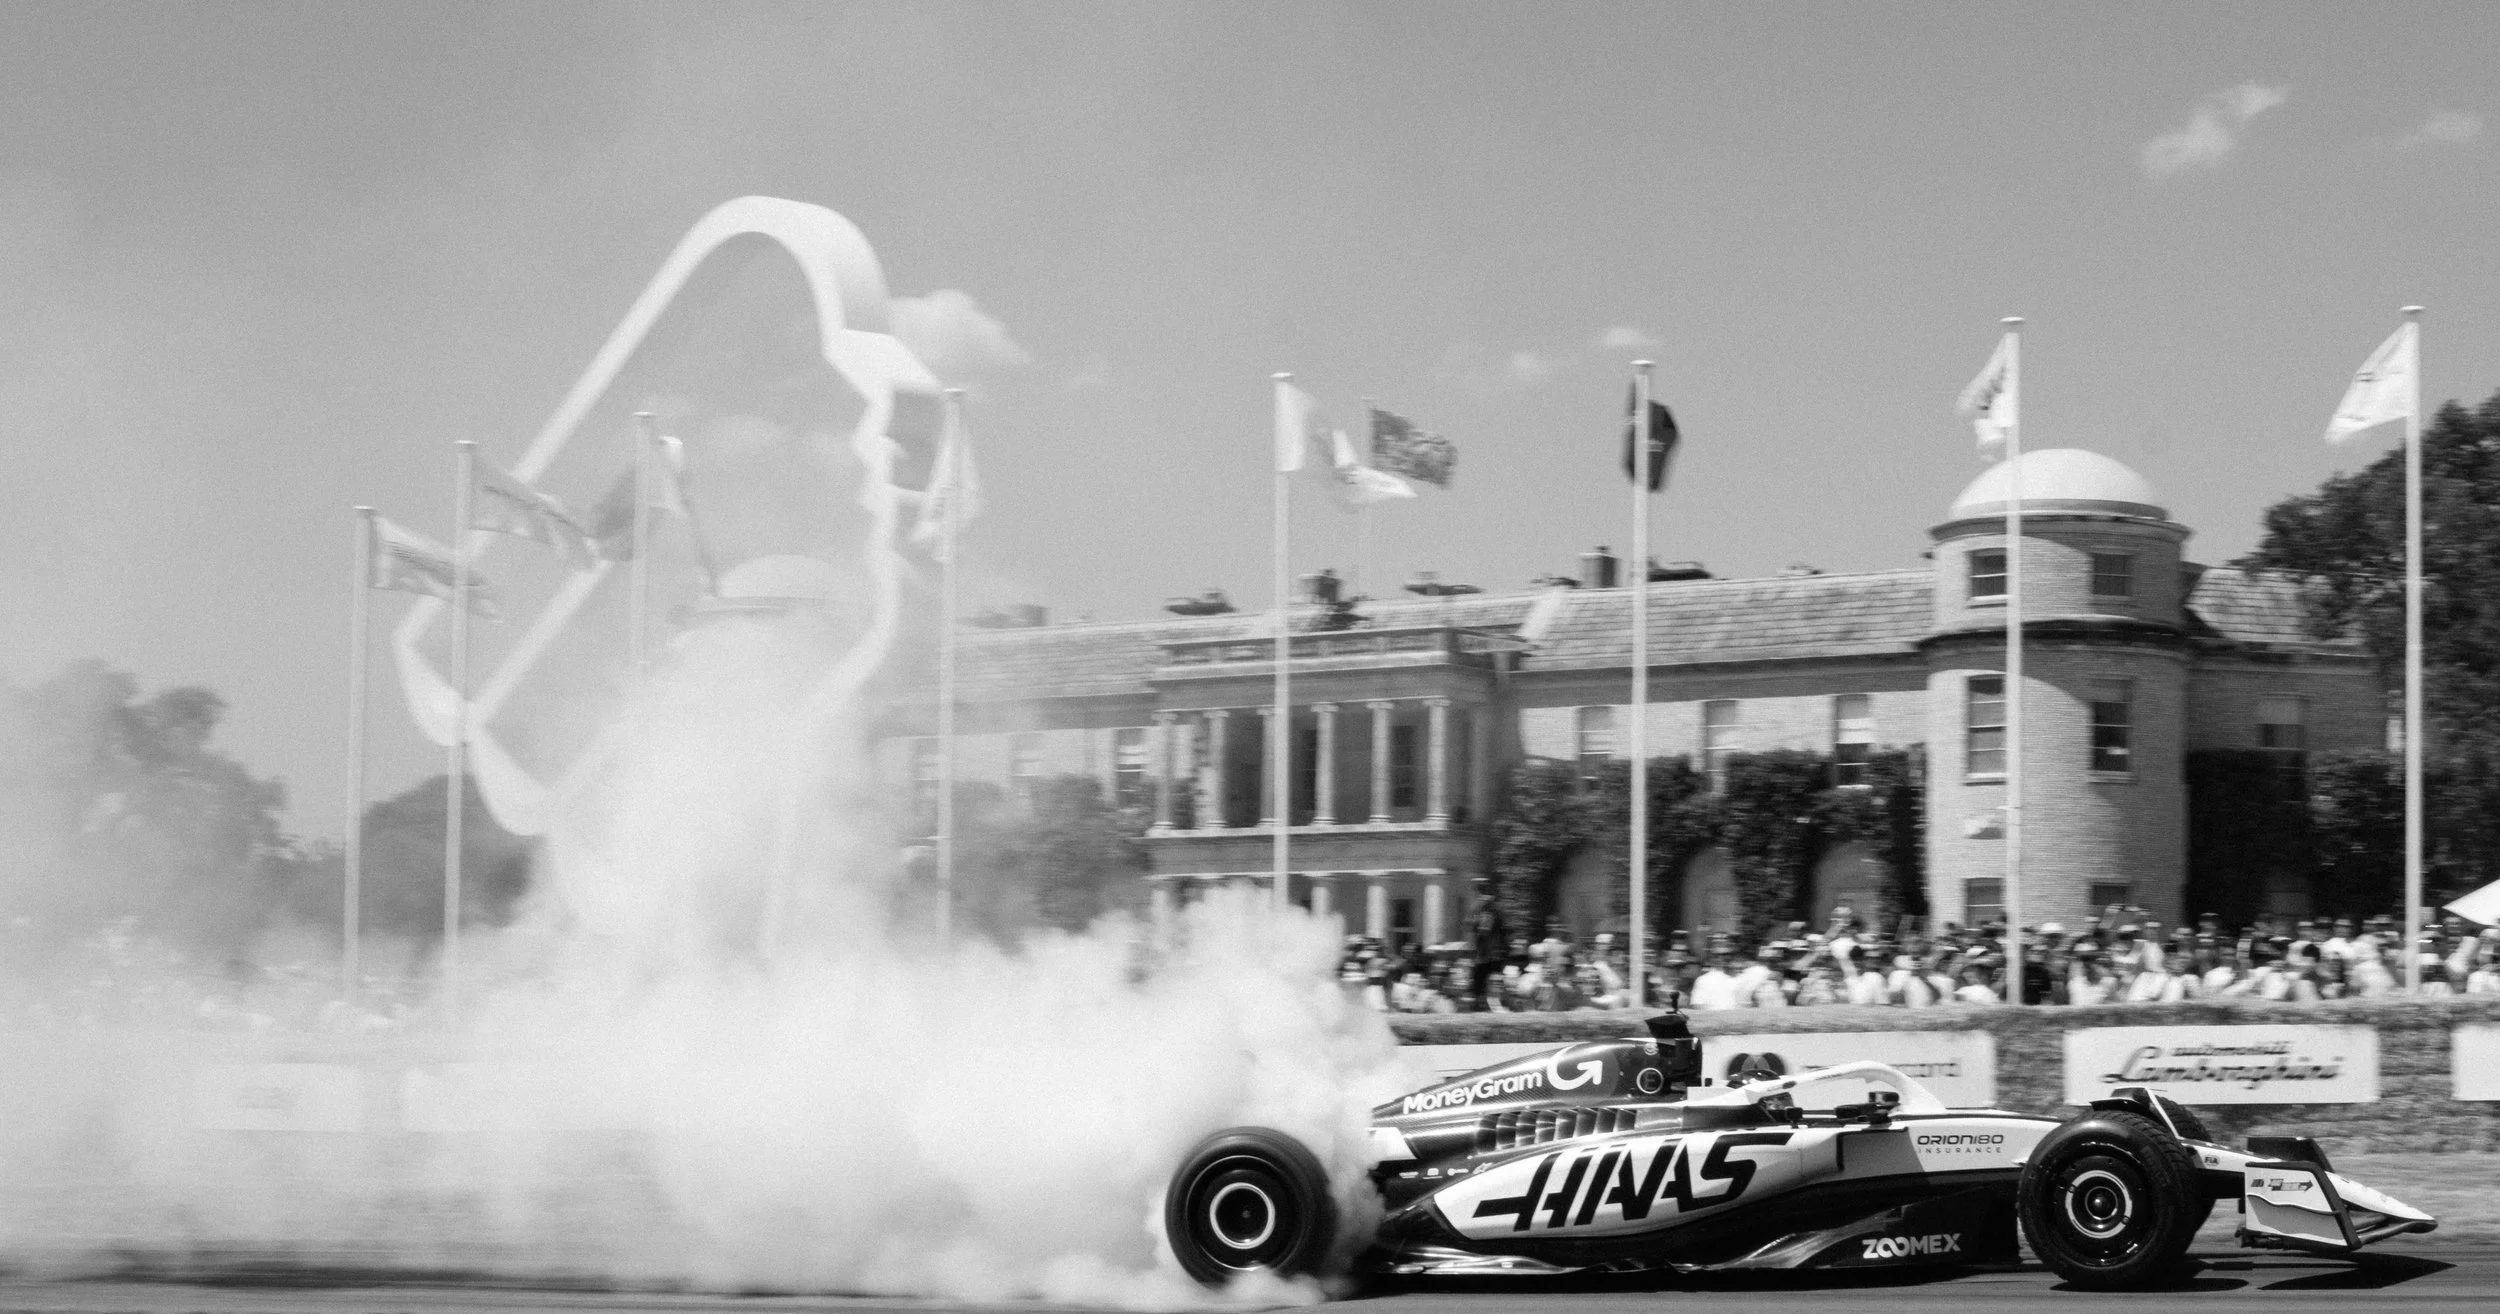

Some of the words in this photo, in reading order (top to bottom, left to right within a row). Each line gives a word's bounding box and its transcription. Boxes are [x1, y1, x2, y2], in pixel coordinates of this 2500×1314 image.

[2099, 1045, 2346, 1090] Lamborghini
[1403, 1072, 1542, 1114] MoneyGram
[1917, 1134, 2004, 1145] ORION180
[1918, 1146, 2001, 1154] INSURANCE
[1472, 1132, 1795, 1232] HAAS
[1862, 1233, 1961, 1259] ZOOMEX
